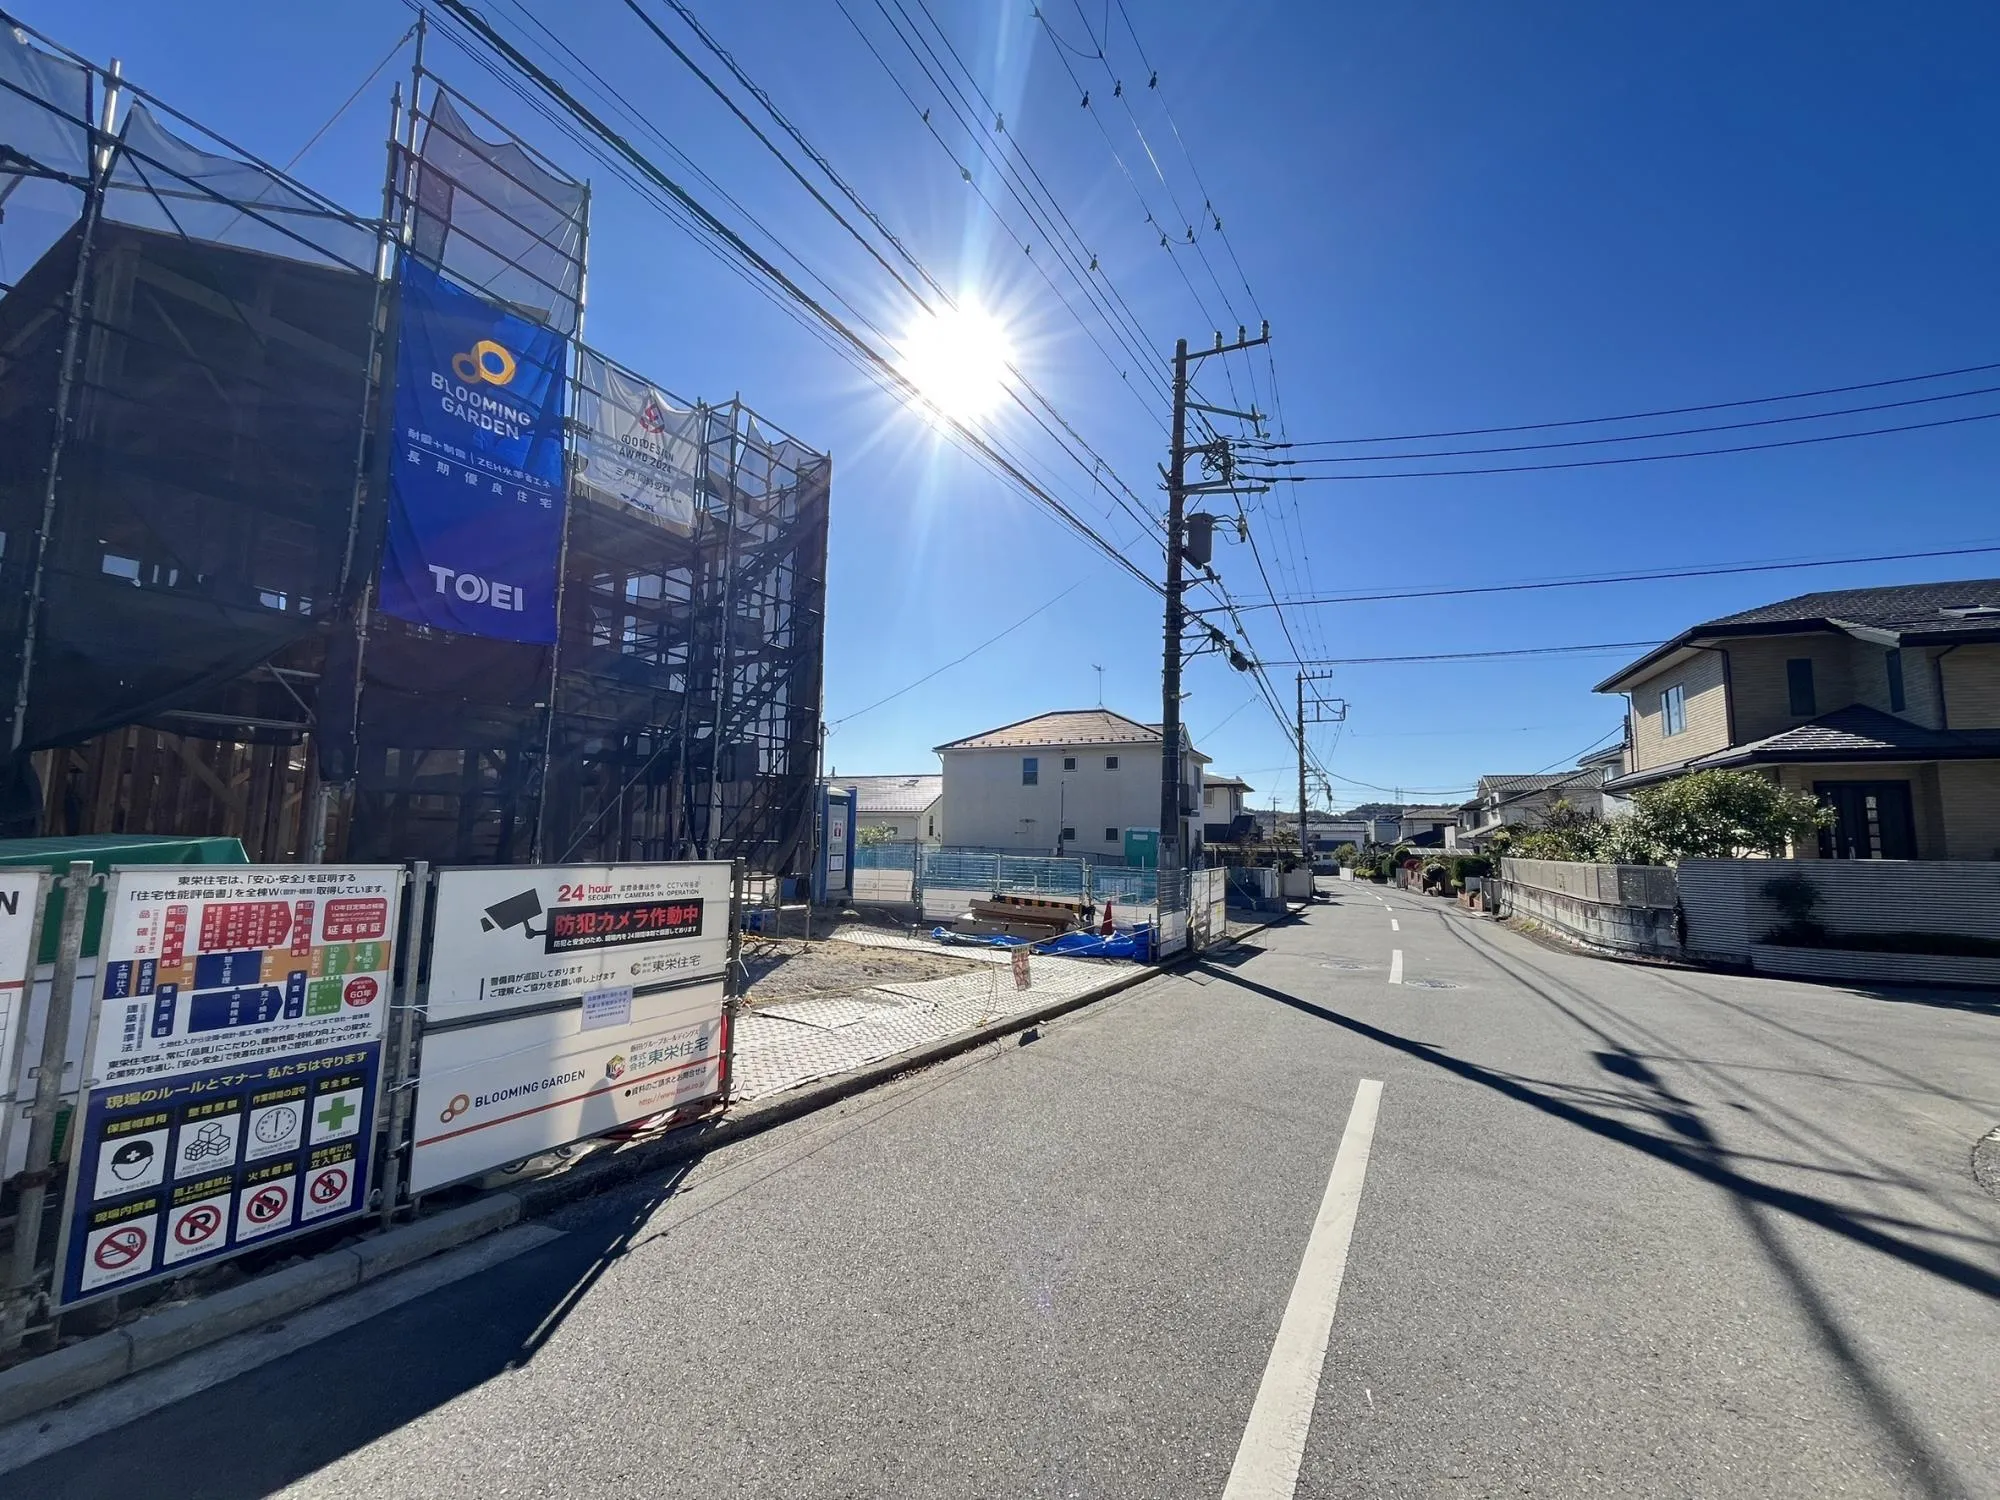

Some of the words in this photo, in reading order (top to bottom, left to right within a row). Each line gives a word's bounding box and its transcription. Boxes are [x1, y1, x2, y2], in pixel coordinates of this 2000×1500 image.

[431, 371, 531, 426] BLOOMING
[441, 396, 520, 441] GARDEN
[407, 449, 553, 509] 長期優良住宅
[428, 563, 524, 612] TOEI
[557, 884, 585, 902] 24
[588, 883, 613, 895] hour
[587, 893, 621, 902] SECURITY
[624, 891, 655, 899] CAMERAS
[666, 888, 699, 897] OPERATION
[327, 922, 381, 935] 延長保証
[554, 904, 699, 937] 防犯カメラ作動中
[114, 963, 129, 996] 土地仕入
[652, 954, 701, 973] 東栄住宅
[350, 989, 372, 999] 60年
[489, 971, 616, 998] ご理解とご協力をお願い申し上げます
[647, 1036, 709, 1066] 東栄住宅
[105, 1072, 263, 1109] 現場のルールとマナー
[267, 1051, 368, 1079] 私たちは守ります
[474, 1081, 539, 1108] BLOOMING
[541, 1069, 586, 1090] GARDEN
